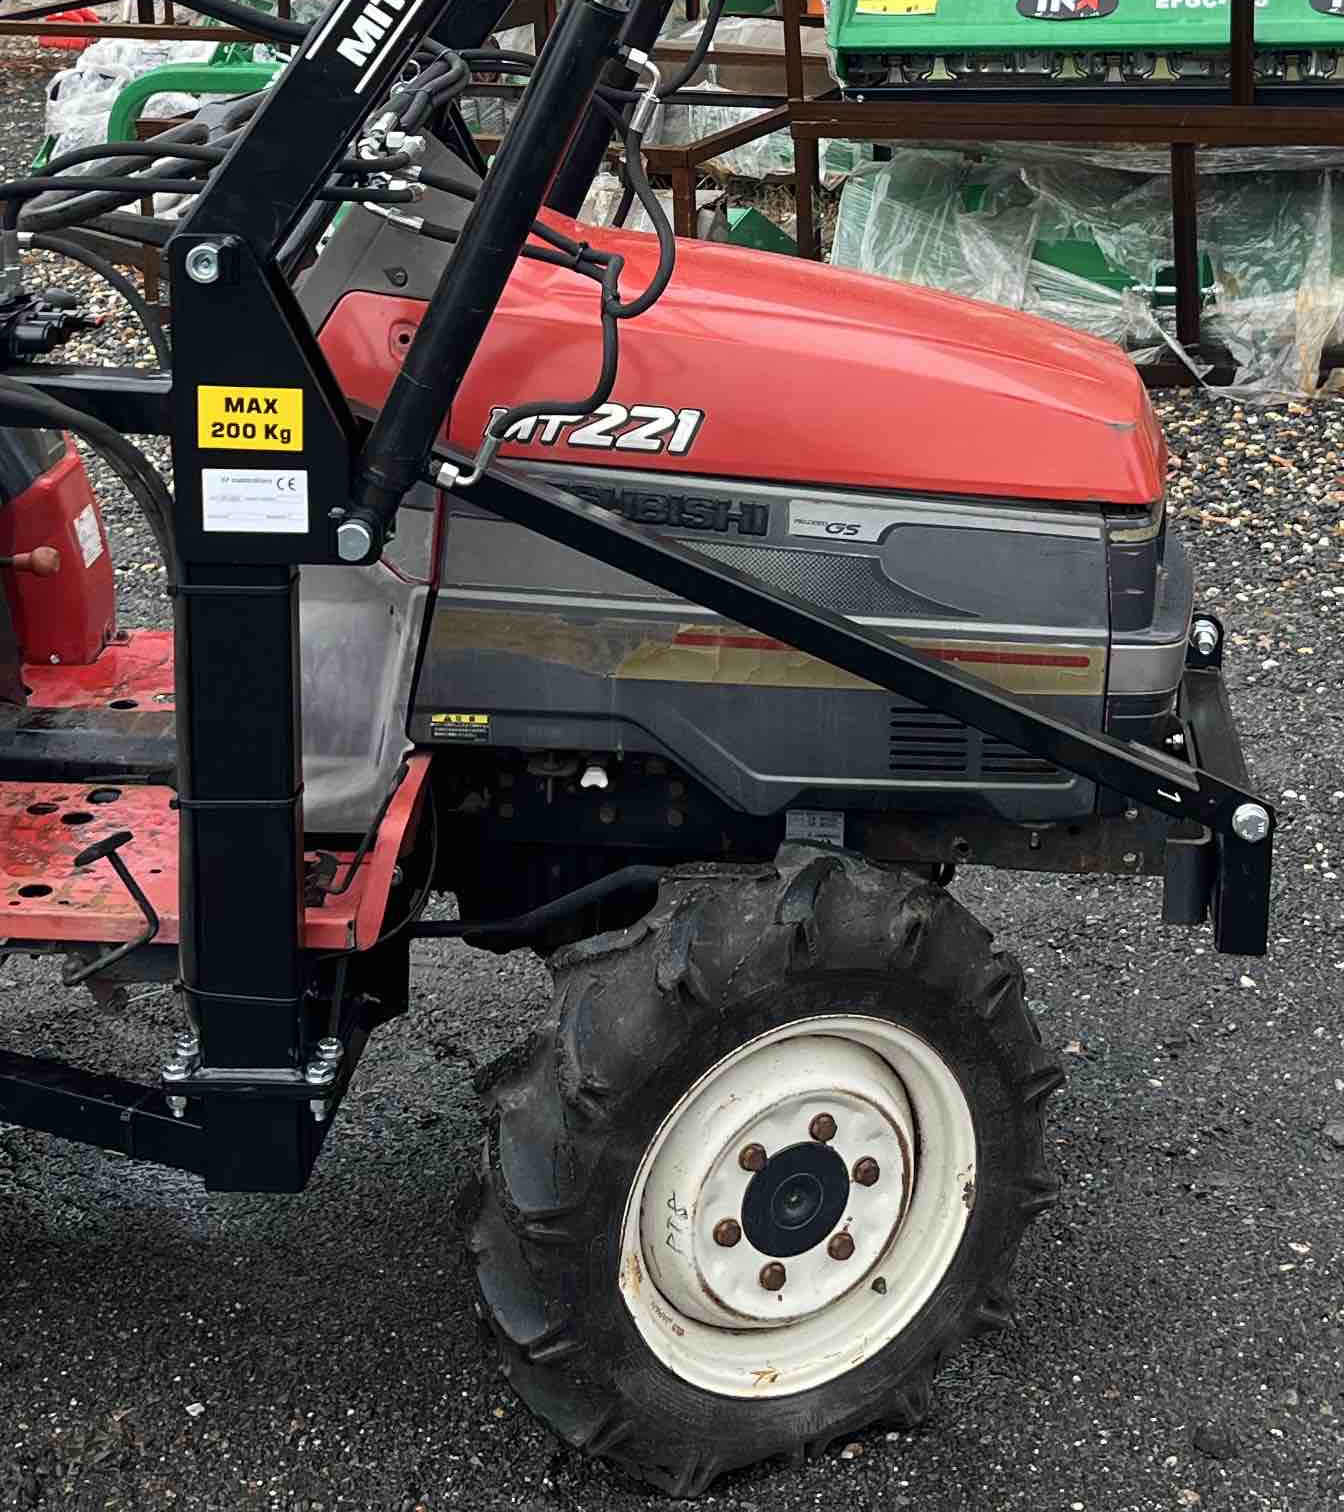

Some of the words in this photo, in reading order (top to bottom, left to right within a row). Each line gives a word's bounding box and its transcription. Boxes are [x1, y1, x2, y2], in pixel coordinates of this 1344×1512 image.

[224, 397, 278, 414] MAX
[211, 422, 256, 439] 200
[264, 424, 291, 444] Kg
[825, 522, 861, 536] GS
